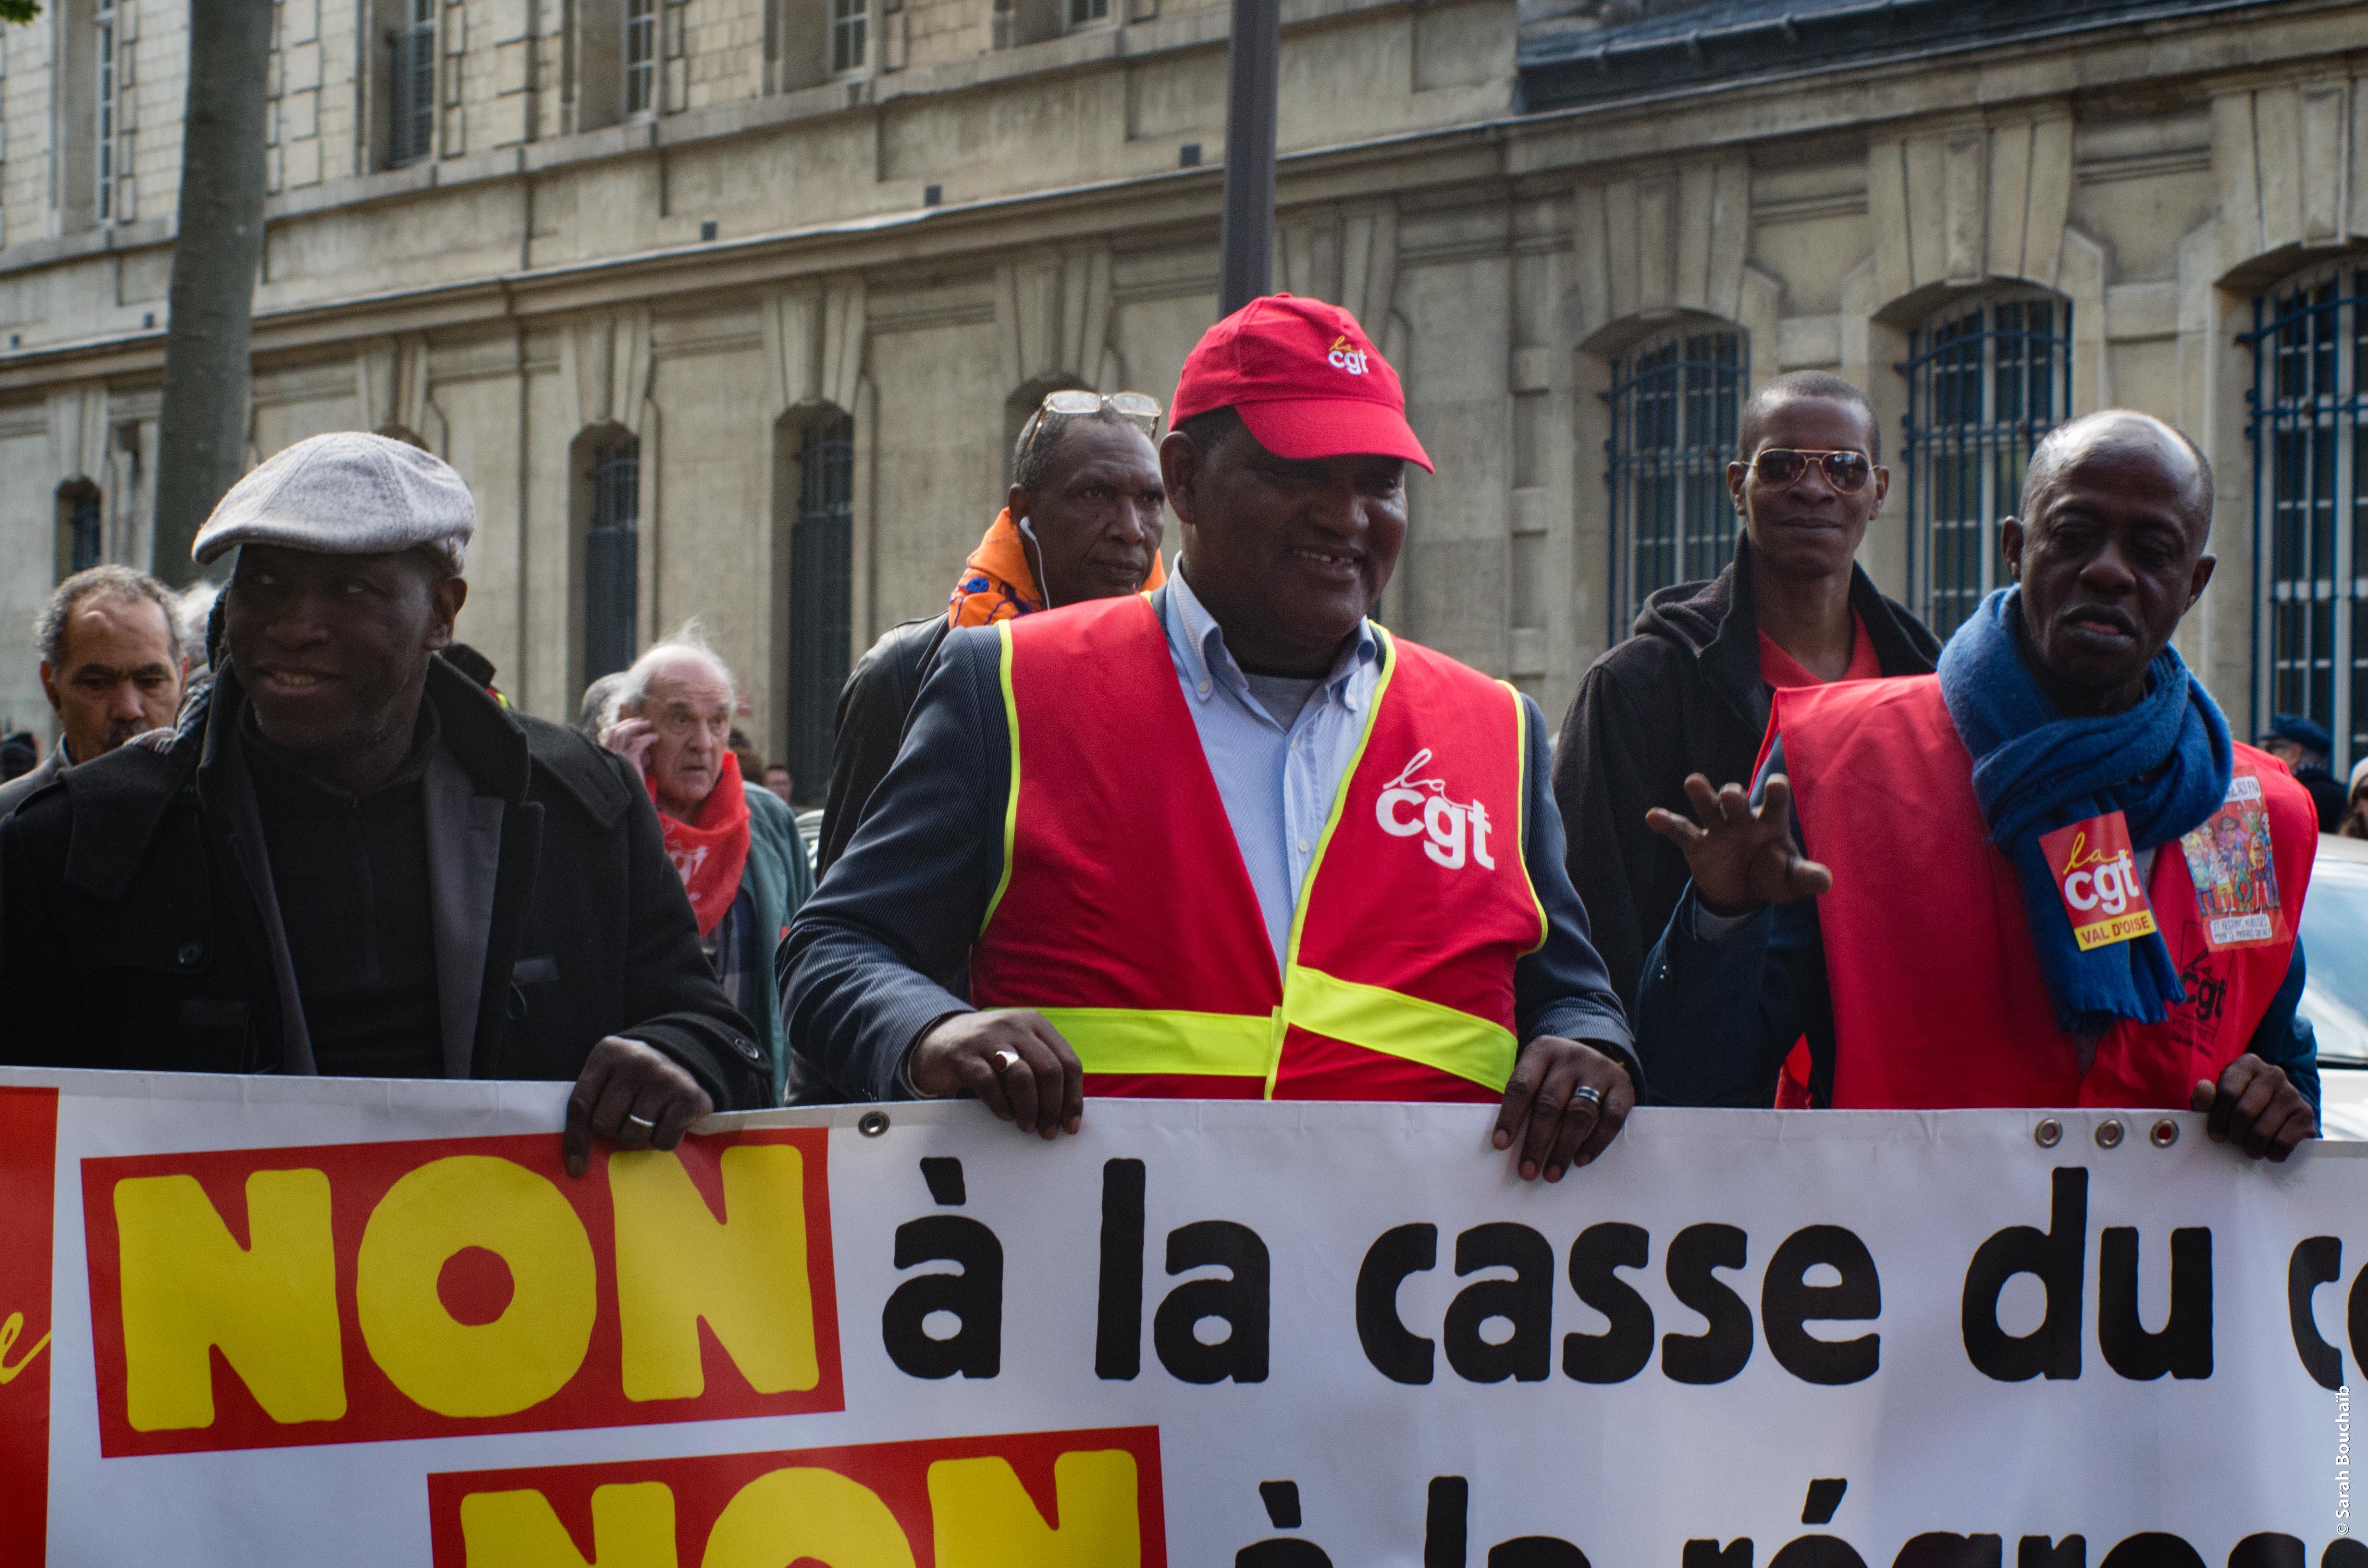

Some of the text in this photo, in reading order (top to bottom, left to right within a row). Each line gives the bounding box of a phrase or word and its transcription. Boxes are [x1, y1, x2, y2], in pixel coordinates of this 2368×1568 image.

[1328, 349, 1369, 375] cgt
[1330, 335, 1361, 353] la
[1383, 748, 1489, 818] la
[1376, 788, 1495, 870] cgt
[2063, 831, 2129, 874] la
[2064, 849, 2140, 915] cgt
[2081, 915, 2150, 944] VAL D'OISE
[2181, 972, 2227, 1021] cgt
[113, 1145, 819, 1431] NON
[882, 1156, 1004, 1379] à
[1094, 1158, 1270, 1384] la
[1356, 1222, 1881, 1385] casse
[1961, 1166, 2213, 1382] du
